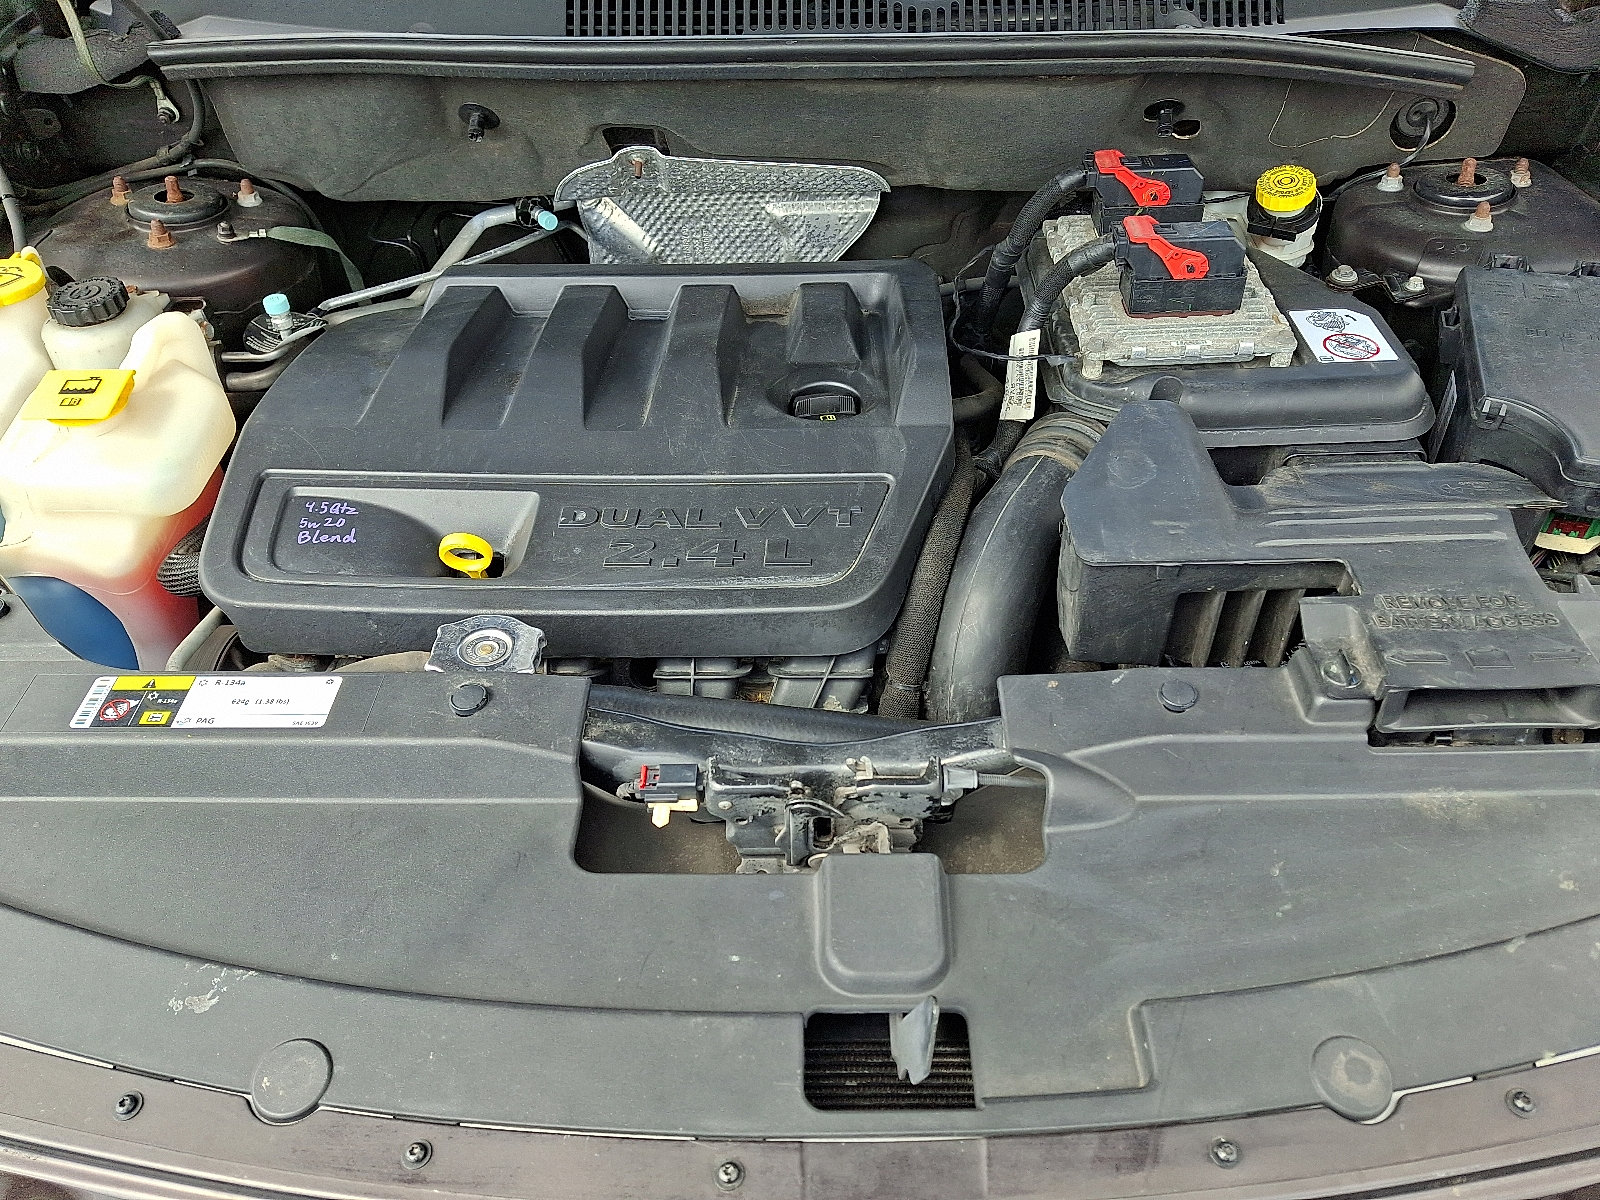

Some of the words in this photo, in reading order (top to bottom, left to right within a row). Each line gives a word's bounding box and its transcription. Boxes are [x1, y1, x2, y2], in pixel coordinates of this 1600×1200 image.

[557, 506, 722, 530] DUAL
[734, 506, 863, 530] VVT
[297, 528, 357, 544] Blend
[195, 717, 216, 725] PAG
